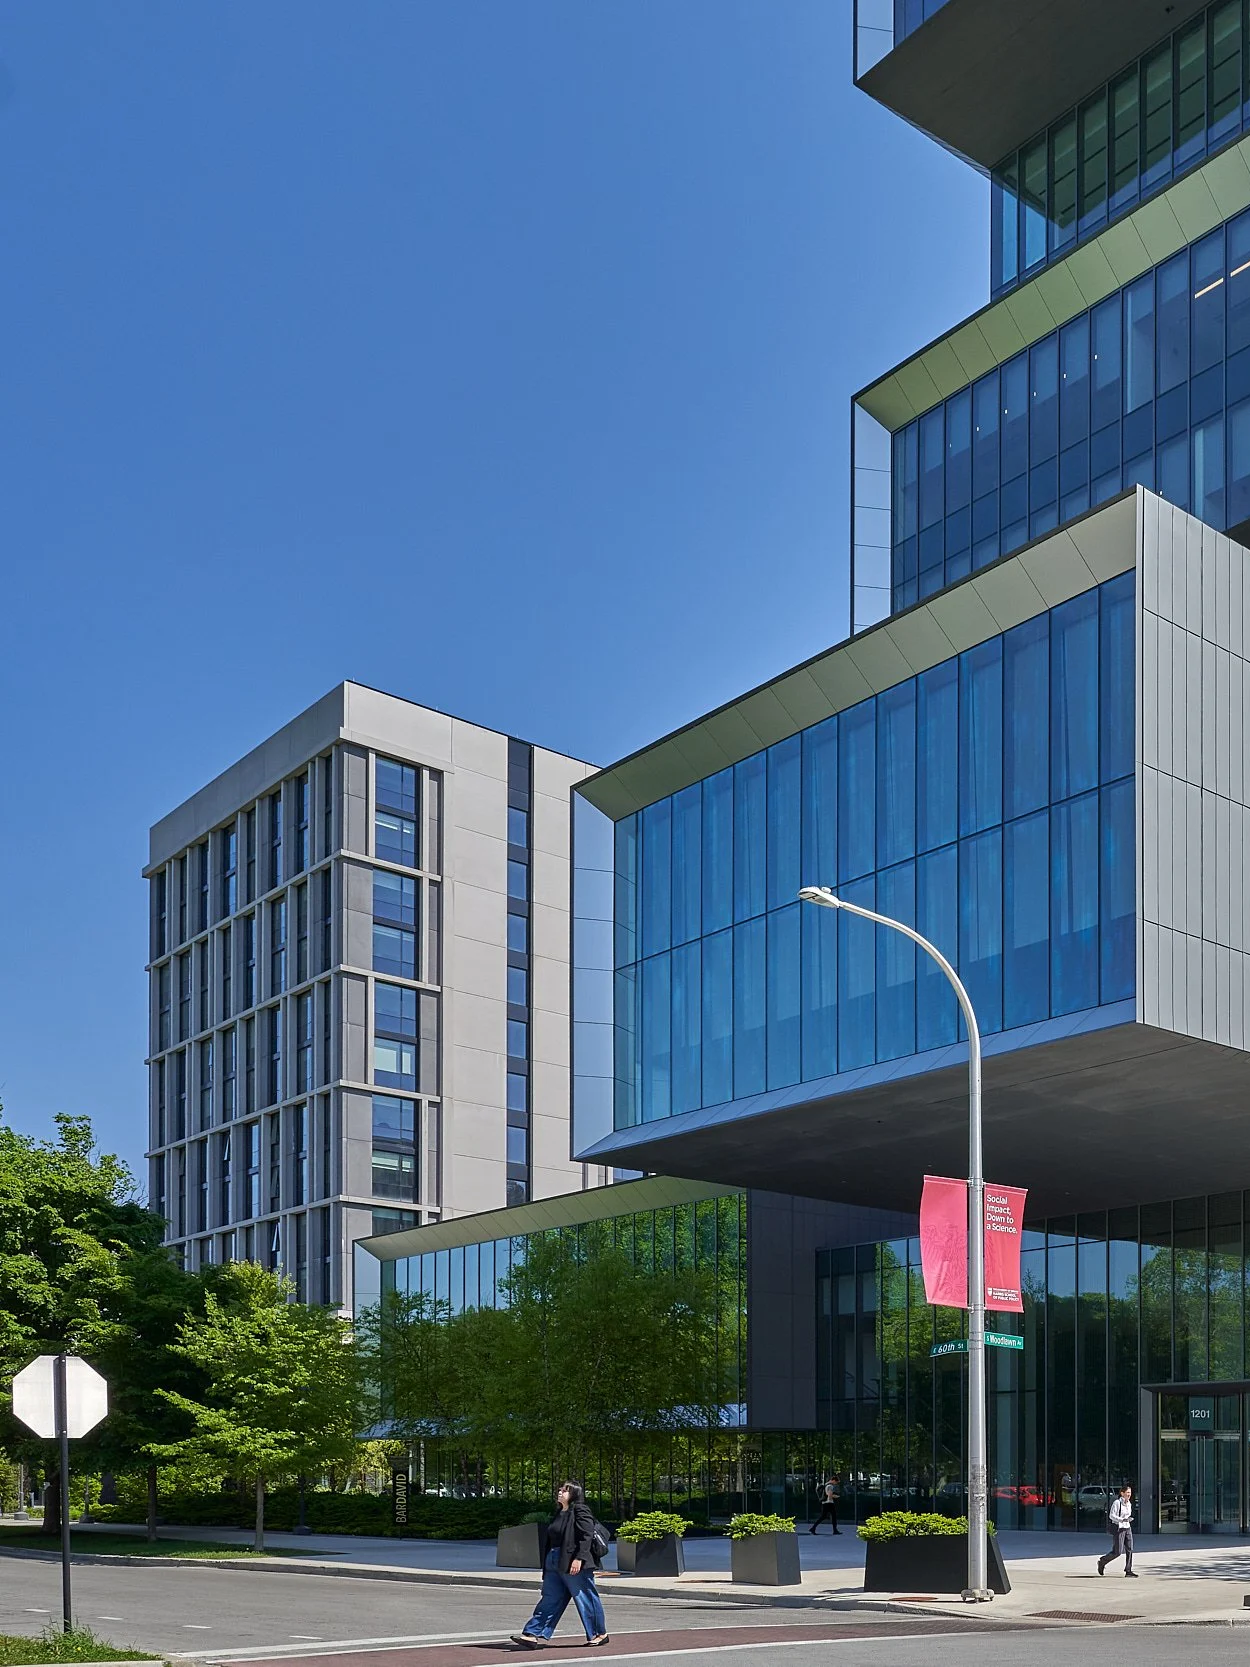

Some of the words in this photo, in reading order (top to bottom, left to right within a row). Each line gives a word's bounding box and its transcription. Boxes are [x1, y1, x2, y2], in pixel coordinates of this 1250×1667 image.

[986, 1194, 1008, 1205] Social
[986, 1204, 1012, 1215] Impact,
[986, 1213, 1005, 1223] Down
[1006, 1216, 1014, 1224] to
[992, 1223, 1018, 1234] Science.
[989, 1334, 1017, 1347] Woodlawn
[938, 1342, 955, 1354] 60th
[1190, 1409, 1210, 1419] 1201
[395, 1473, 407, 1523] BARDAVID
